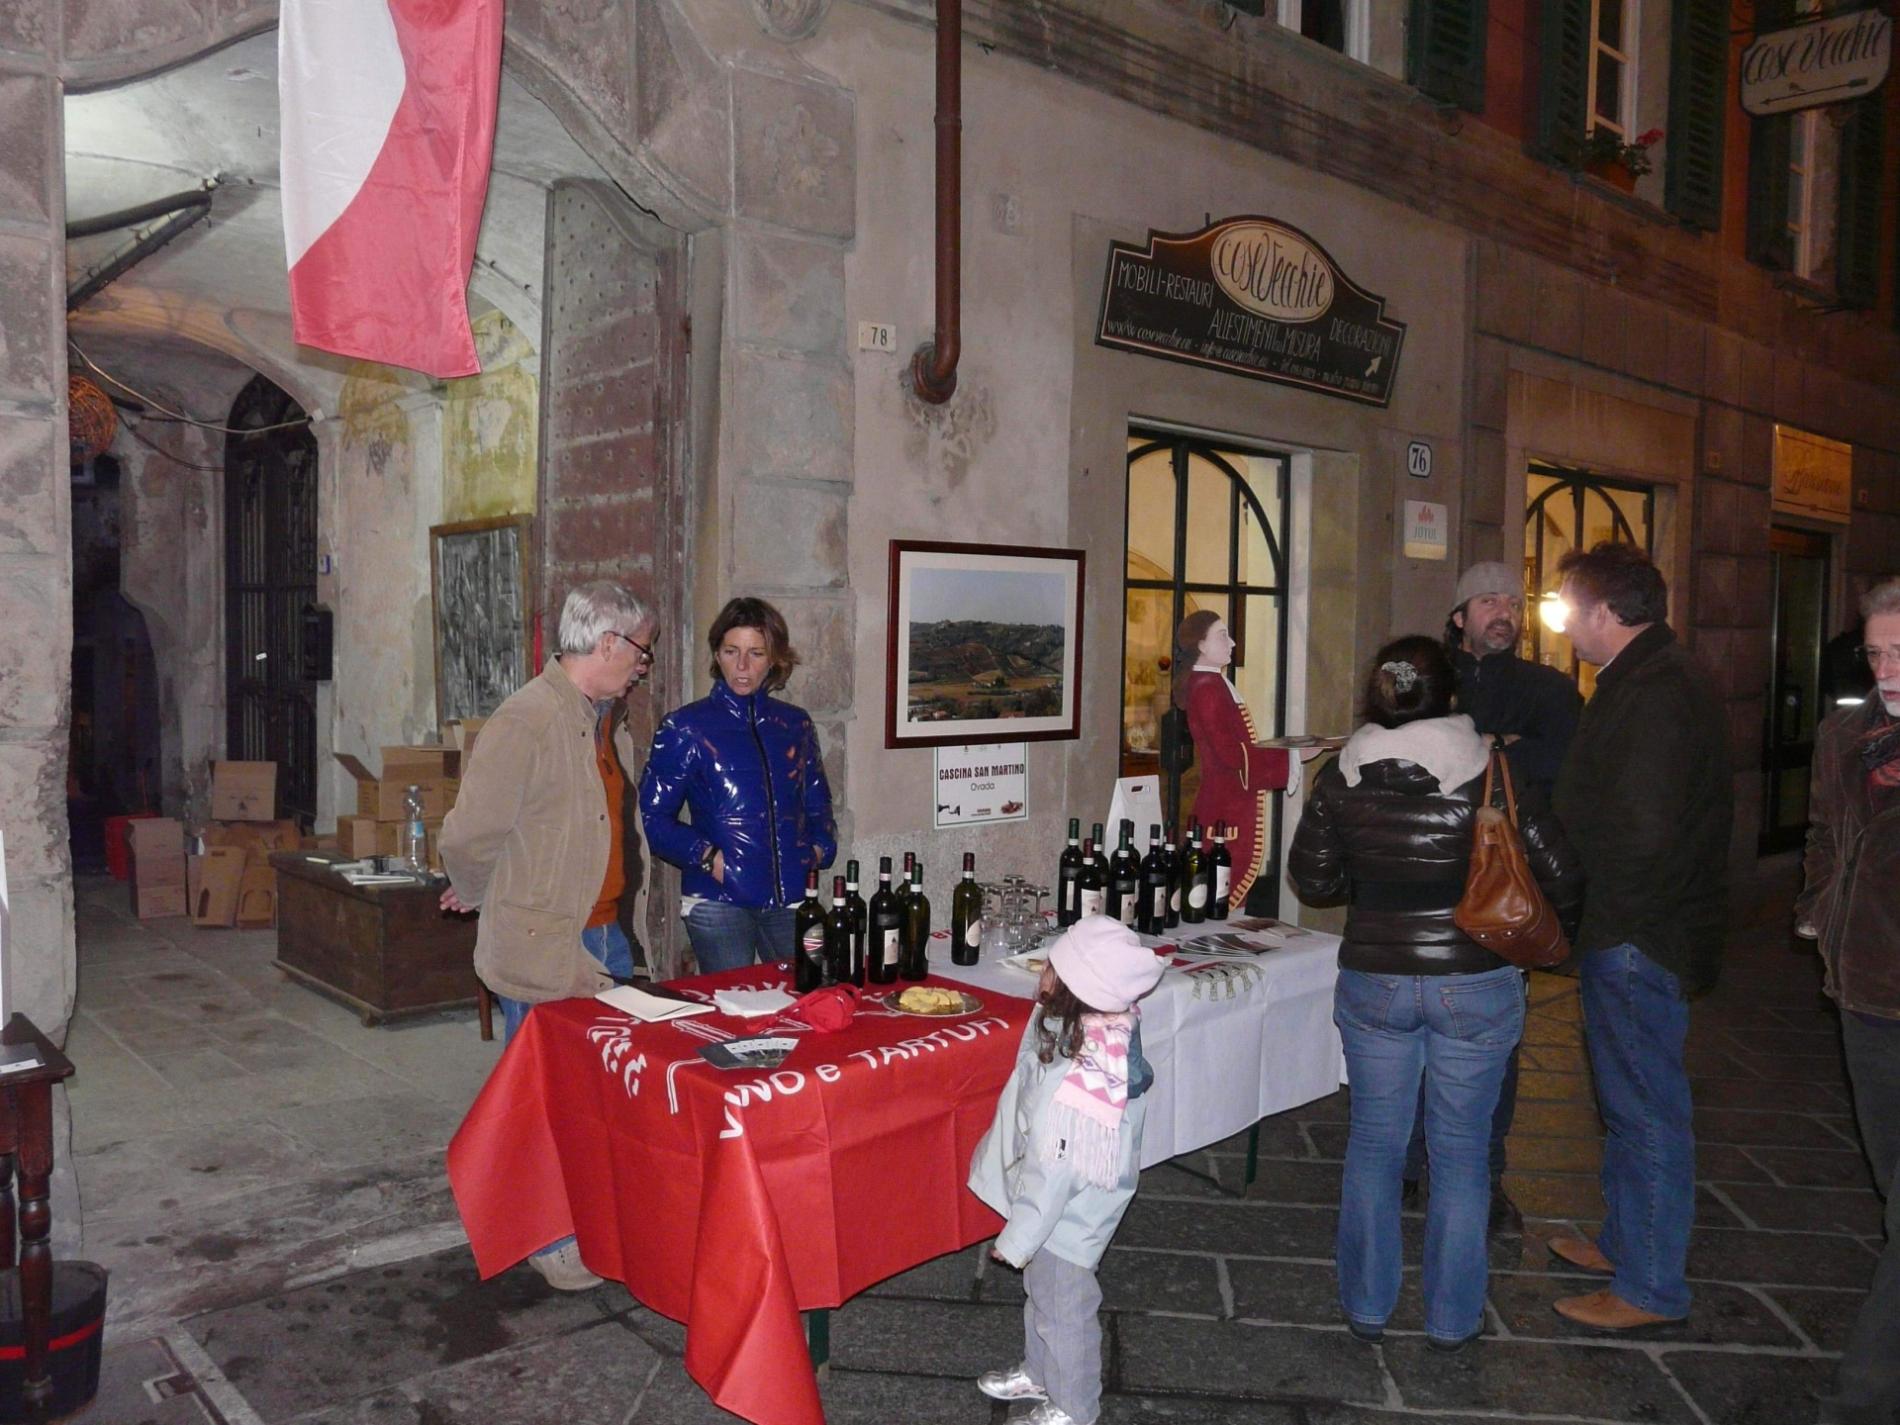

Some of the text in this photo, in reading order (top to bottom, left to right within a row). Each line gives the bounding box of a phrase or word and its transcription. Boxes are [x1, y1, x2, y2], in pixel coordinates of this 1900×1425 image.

[871, 326, 888, 346] 78
[1412, 447, 1427, 472] 76
[940, 763, 1025, 781] CASCINA SAN MARTINO
[970, 782, 996, 792] Ovada
[815, 1063, 842, 1083] e
[848, 1017, 1010, 1069] TARTUFI
